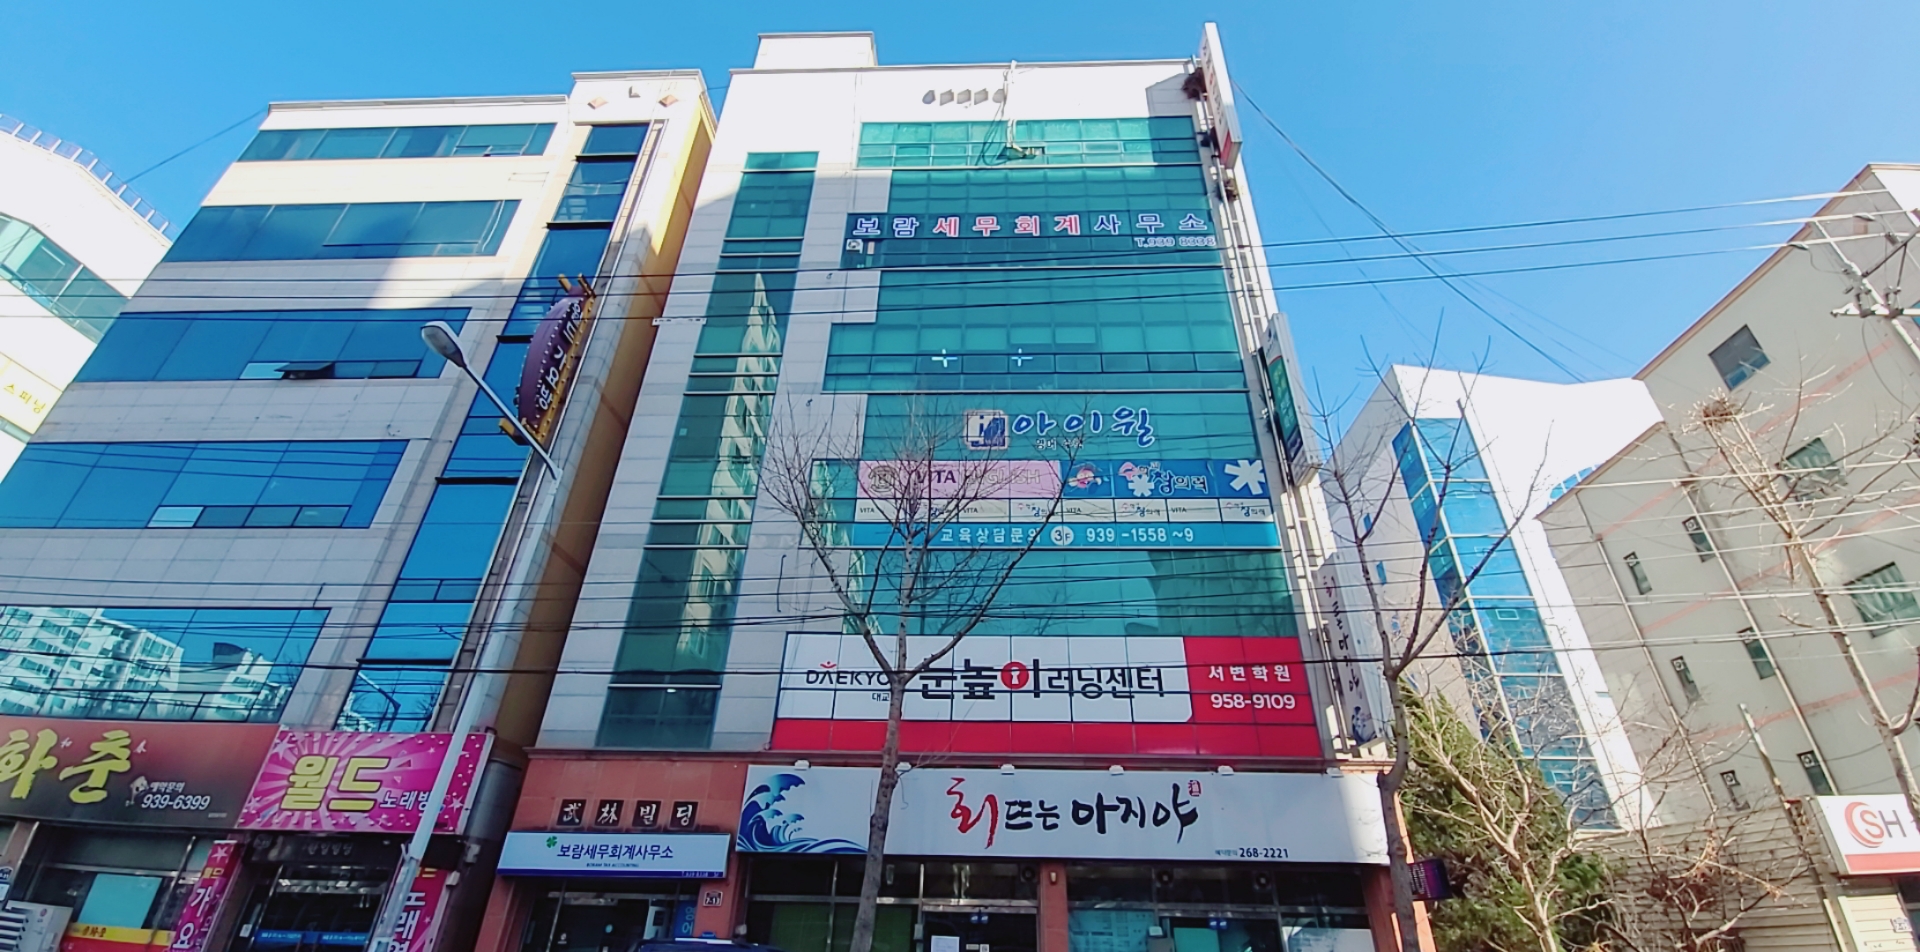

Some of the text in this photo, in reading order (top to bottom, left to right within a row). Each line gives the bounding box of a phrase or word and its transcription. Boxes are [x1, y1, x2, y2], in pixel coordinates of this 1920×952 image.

[1012, 406, 1155, 447] 아이윌
[1086, 527, 1115, 543] 939
[1208, 665, 1292, 682] 서변학원
[1211, 693, 1296, 709] 958-9109
[279, 755, 391, 812] 월드
[141, 794, 210, 810] 939-6399
[946, 777, 1199, 850] 회 뜨는 아지야
[557, 844, 674, 861] 보람세무회계사무소
[1240, 848, 1289, 859] 268-2221
